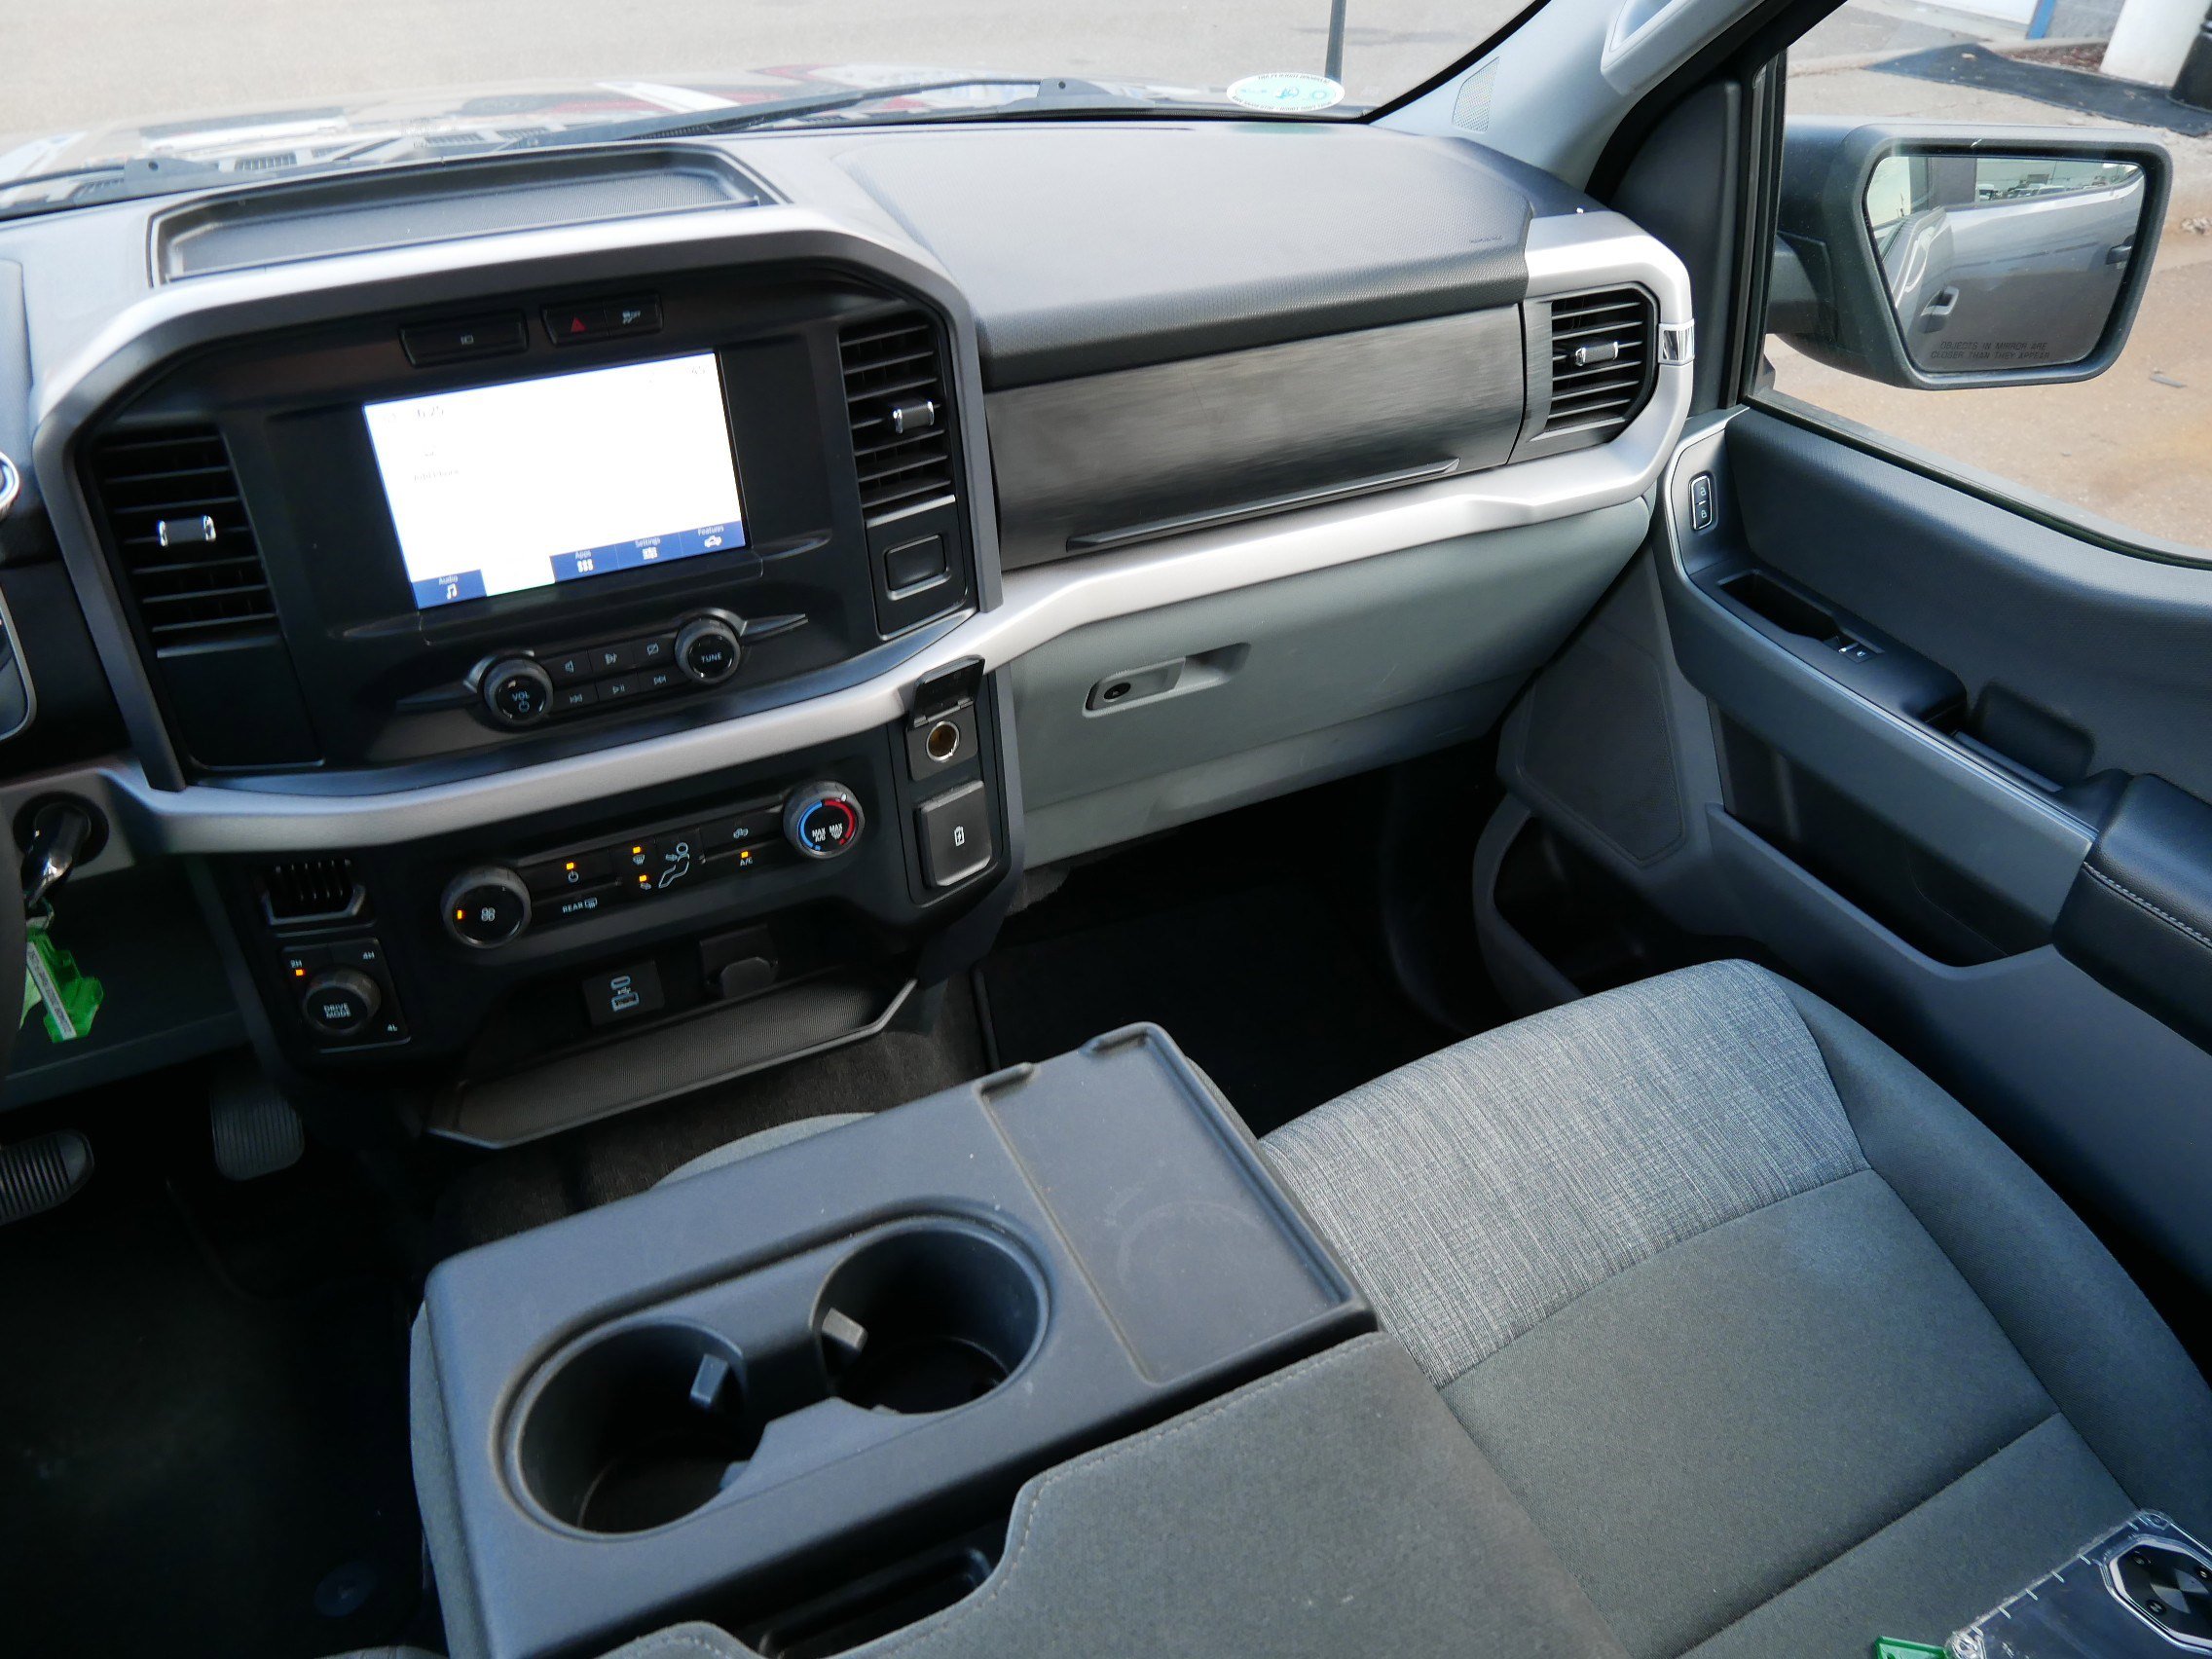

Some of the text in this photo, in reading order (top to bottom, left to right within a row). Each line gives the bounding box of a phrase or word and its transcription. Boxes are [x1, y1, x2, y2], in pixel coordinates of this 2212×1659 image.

[1940, 341, 2048, 350] OBJECTS IN MIRROR ARE
[1931, 350, 1964, 359] CLOSER
[2018, 350, 2050, 359] APPEAR
[697, 525, 724, 536] Features
[635, 536, 661, 548] Settings
[574, 550, 592, 561] Apps
[438, 574, 459, 585] Audio
[701, 651, 722, 663] TUNE
[511, 690, 530, 702] VOL
[812, 823, 843, 838] MAX MAX
[740, 856, 754, 866] A/C
[562, 902, 583, 913] REAR
[362, 950, 375, 960] 4H
[323, 1002, 349, 1013] DRIVE
[325, 1010, 351, 1019] MODE
[387, 1023, 398, 1032] 4L
